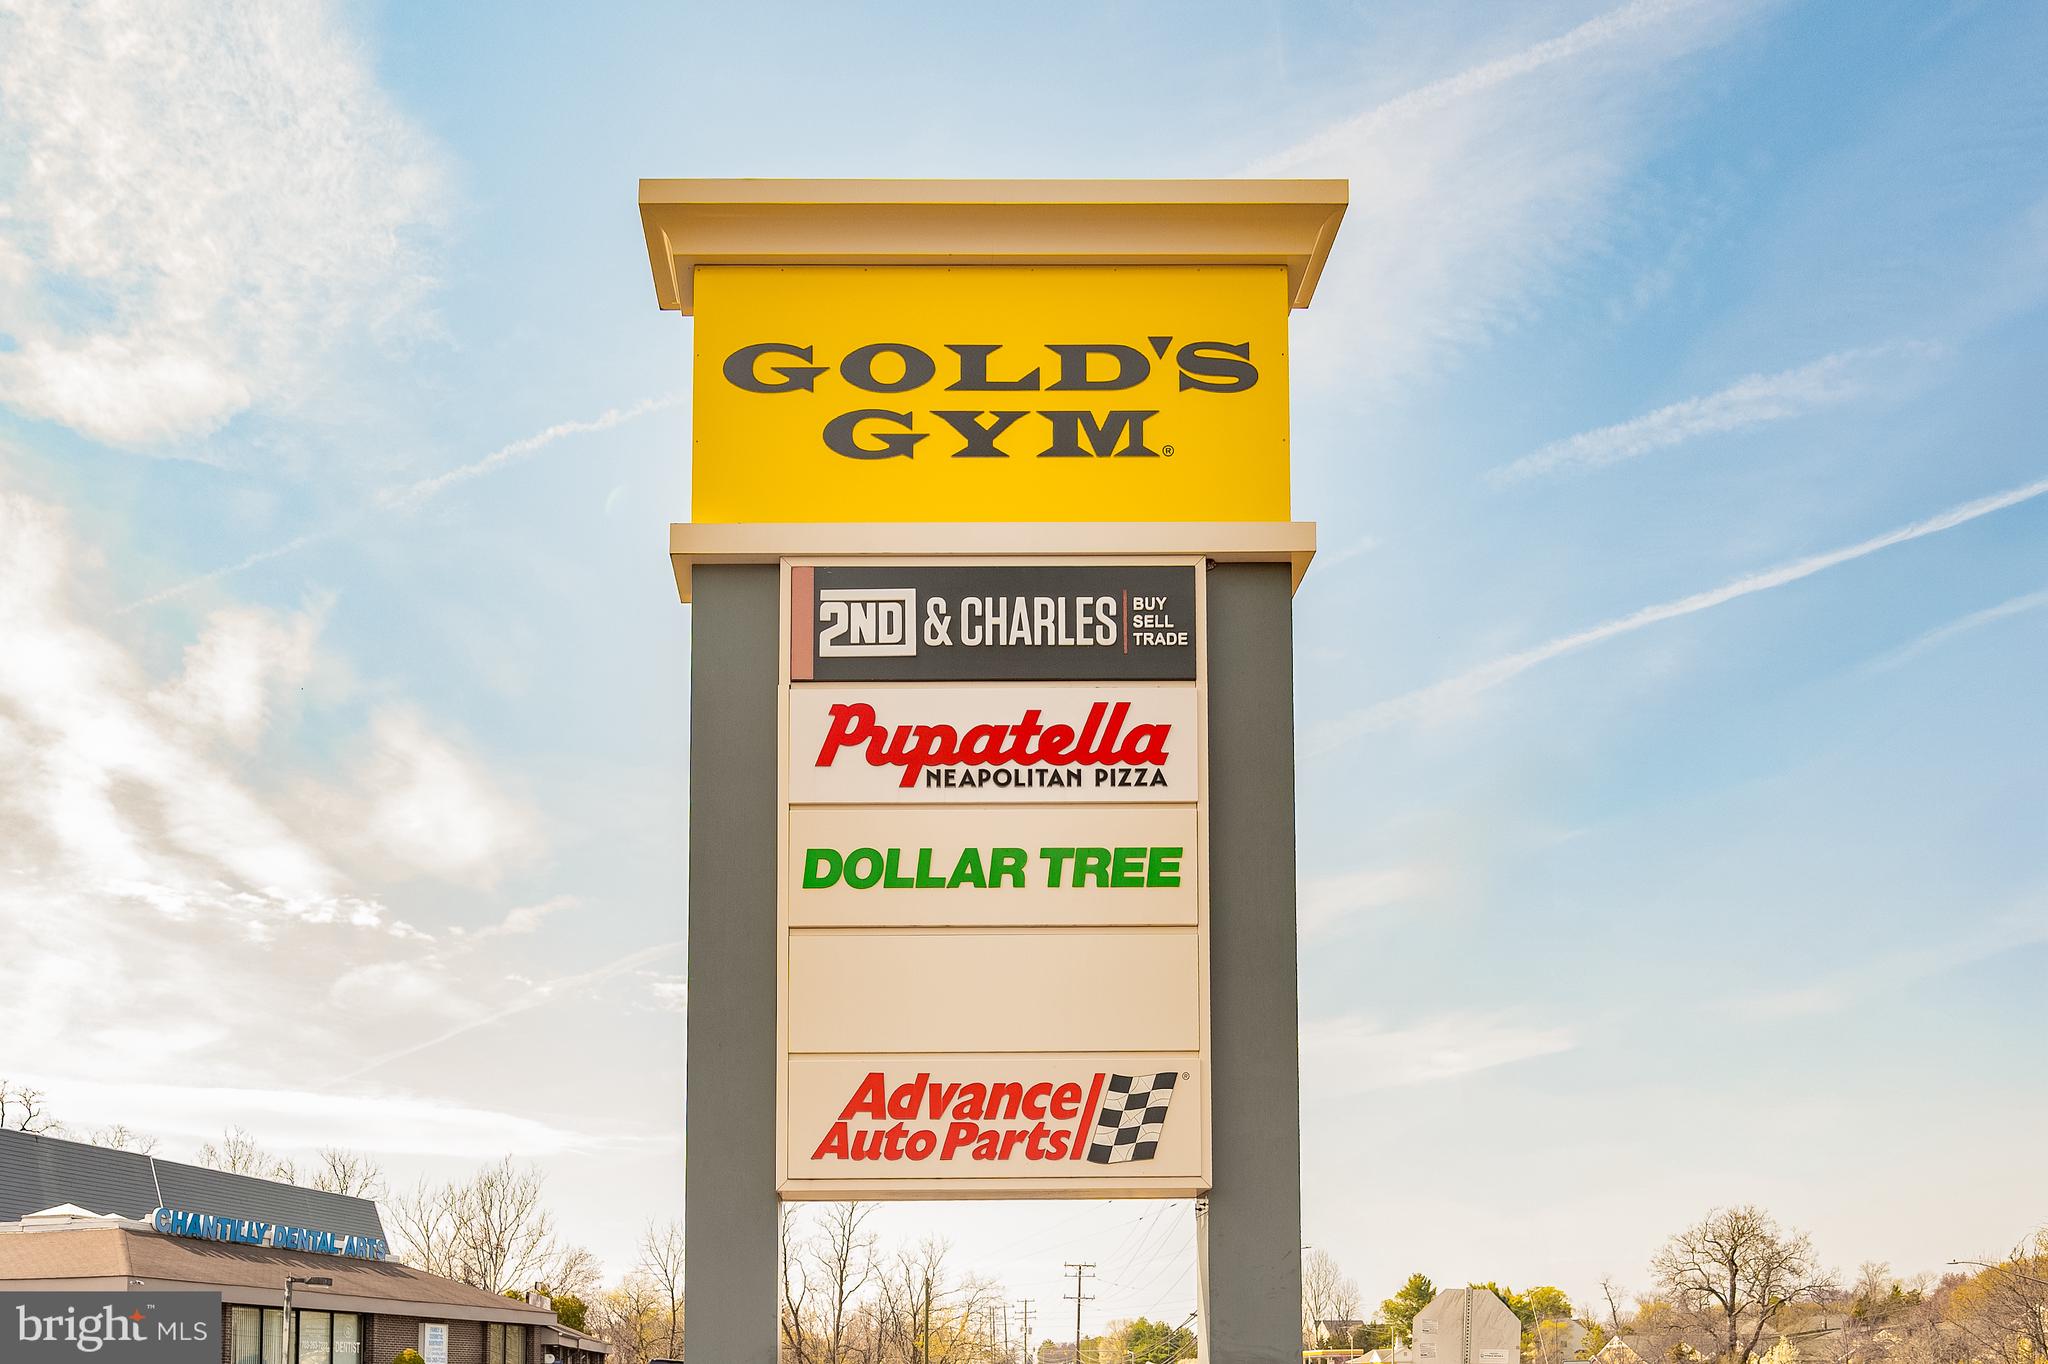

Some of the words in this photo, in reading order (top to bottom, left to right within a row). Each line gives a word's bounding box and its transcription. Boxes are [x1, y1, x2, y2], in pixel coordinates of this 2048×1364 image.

[723, 336, 1259, 393] GOLD'S
[823, 409, 1160, 459] GYM
[819, 598, 905, 648] 2ND
[924, 597, 953, 646] &
[960, 597, 1118, 646] CHARLES
[1133, 597, 1168, 611] BUY
[1133, 614, 1174, 628] SELL
[1133, 632, 1189, 646] TRADE
[814, 702, 1172, 789] Pupatella
[926, 768, 1082, 788] NEAPOLITAN
[1095, 768, 1168, 787] PIZZA
[802, 847, 1028, 889] DOLLAR
[1040, 847, 1183, 888] TREE
[838, 1072, 1082, 1120] Advance
[811, 1121, 937, 1162] Auto
[940, 1121, 1071, 1162] Parts
[153, 1207, 269, 1244] CHANTILLY
[273, 1225, 340, 1255] DENTAL
[344, 1235, 387, 1260] ARTS
[335, 1341, 361, 1353] DENTIST
